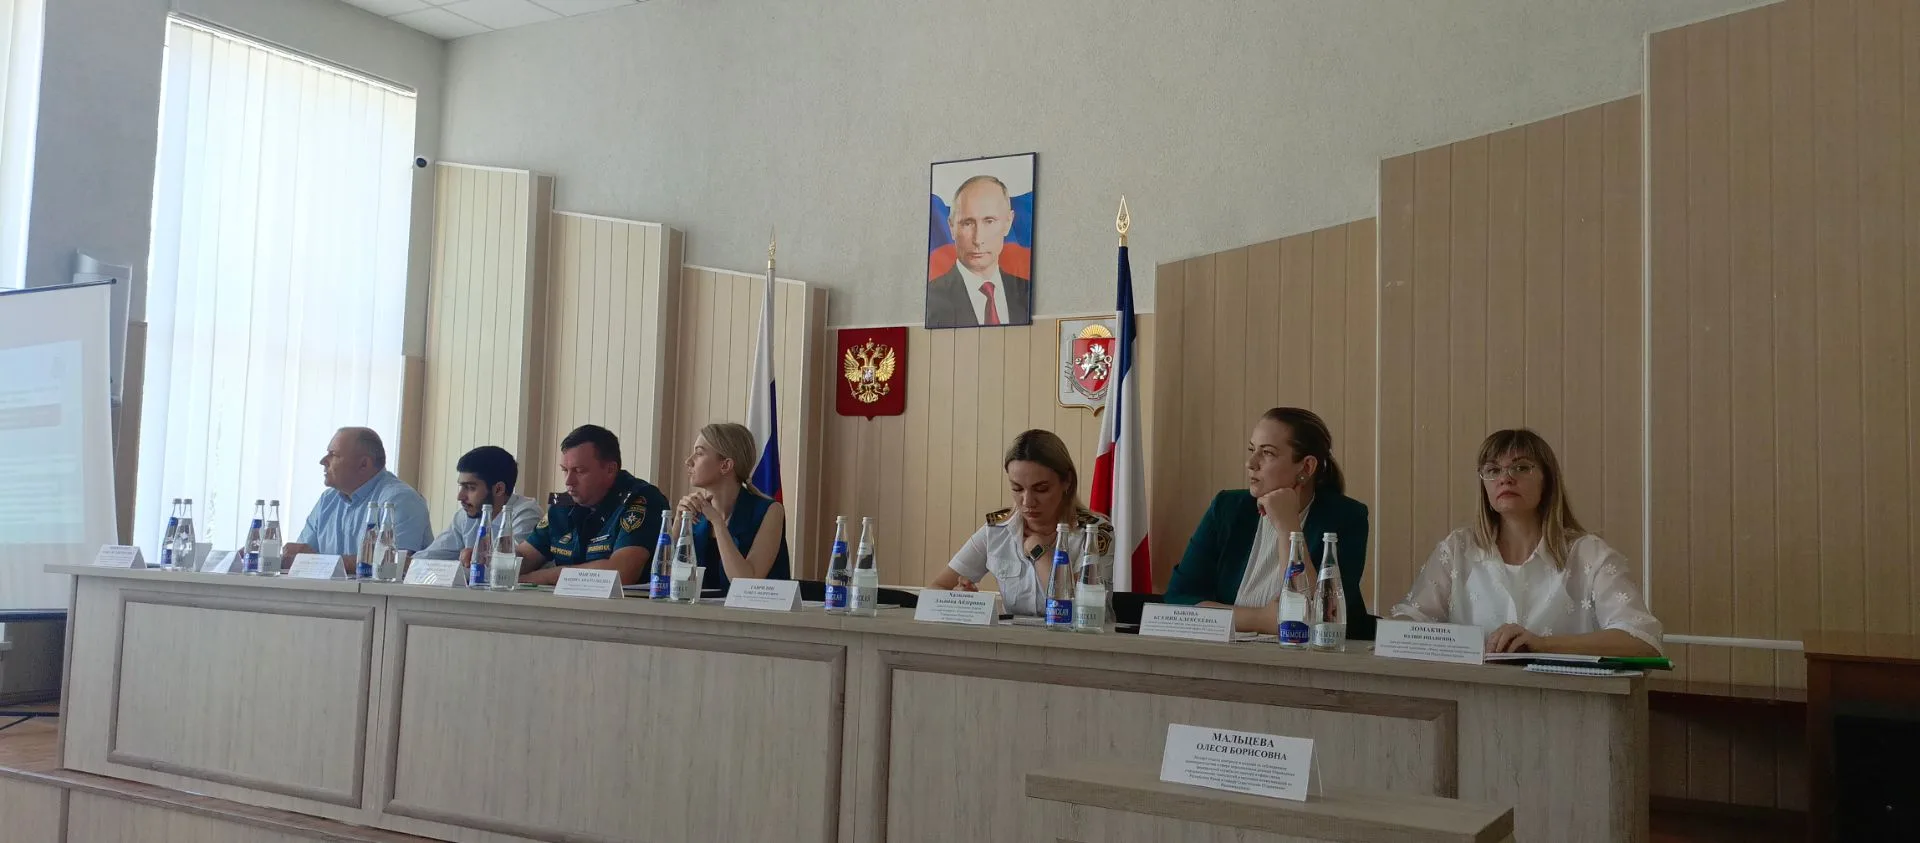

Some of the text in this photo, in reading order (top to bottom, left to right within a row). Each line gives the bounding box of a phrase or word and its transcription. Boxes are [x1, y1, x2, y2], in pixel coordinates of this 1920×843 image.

[1211, 732, 1275, 748] МАЛЬЦЕВА
[1196, 742, 1288, 761] ОЛЕСЯ БОРИСОВНА
